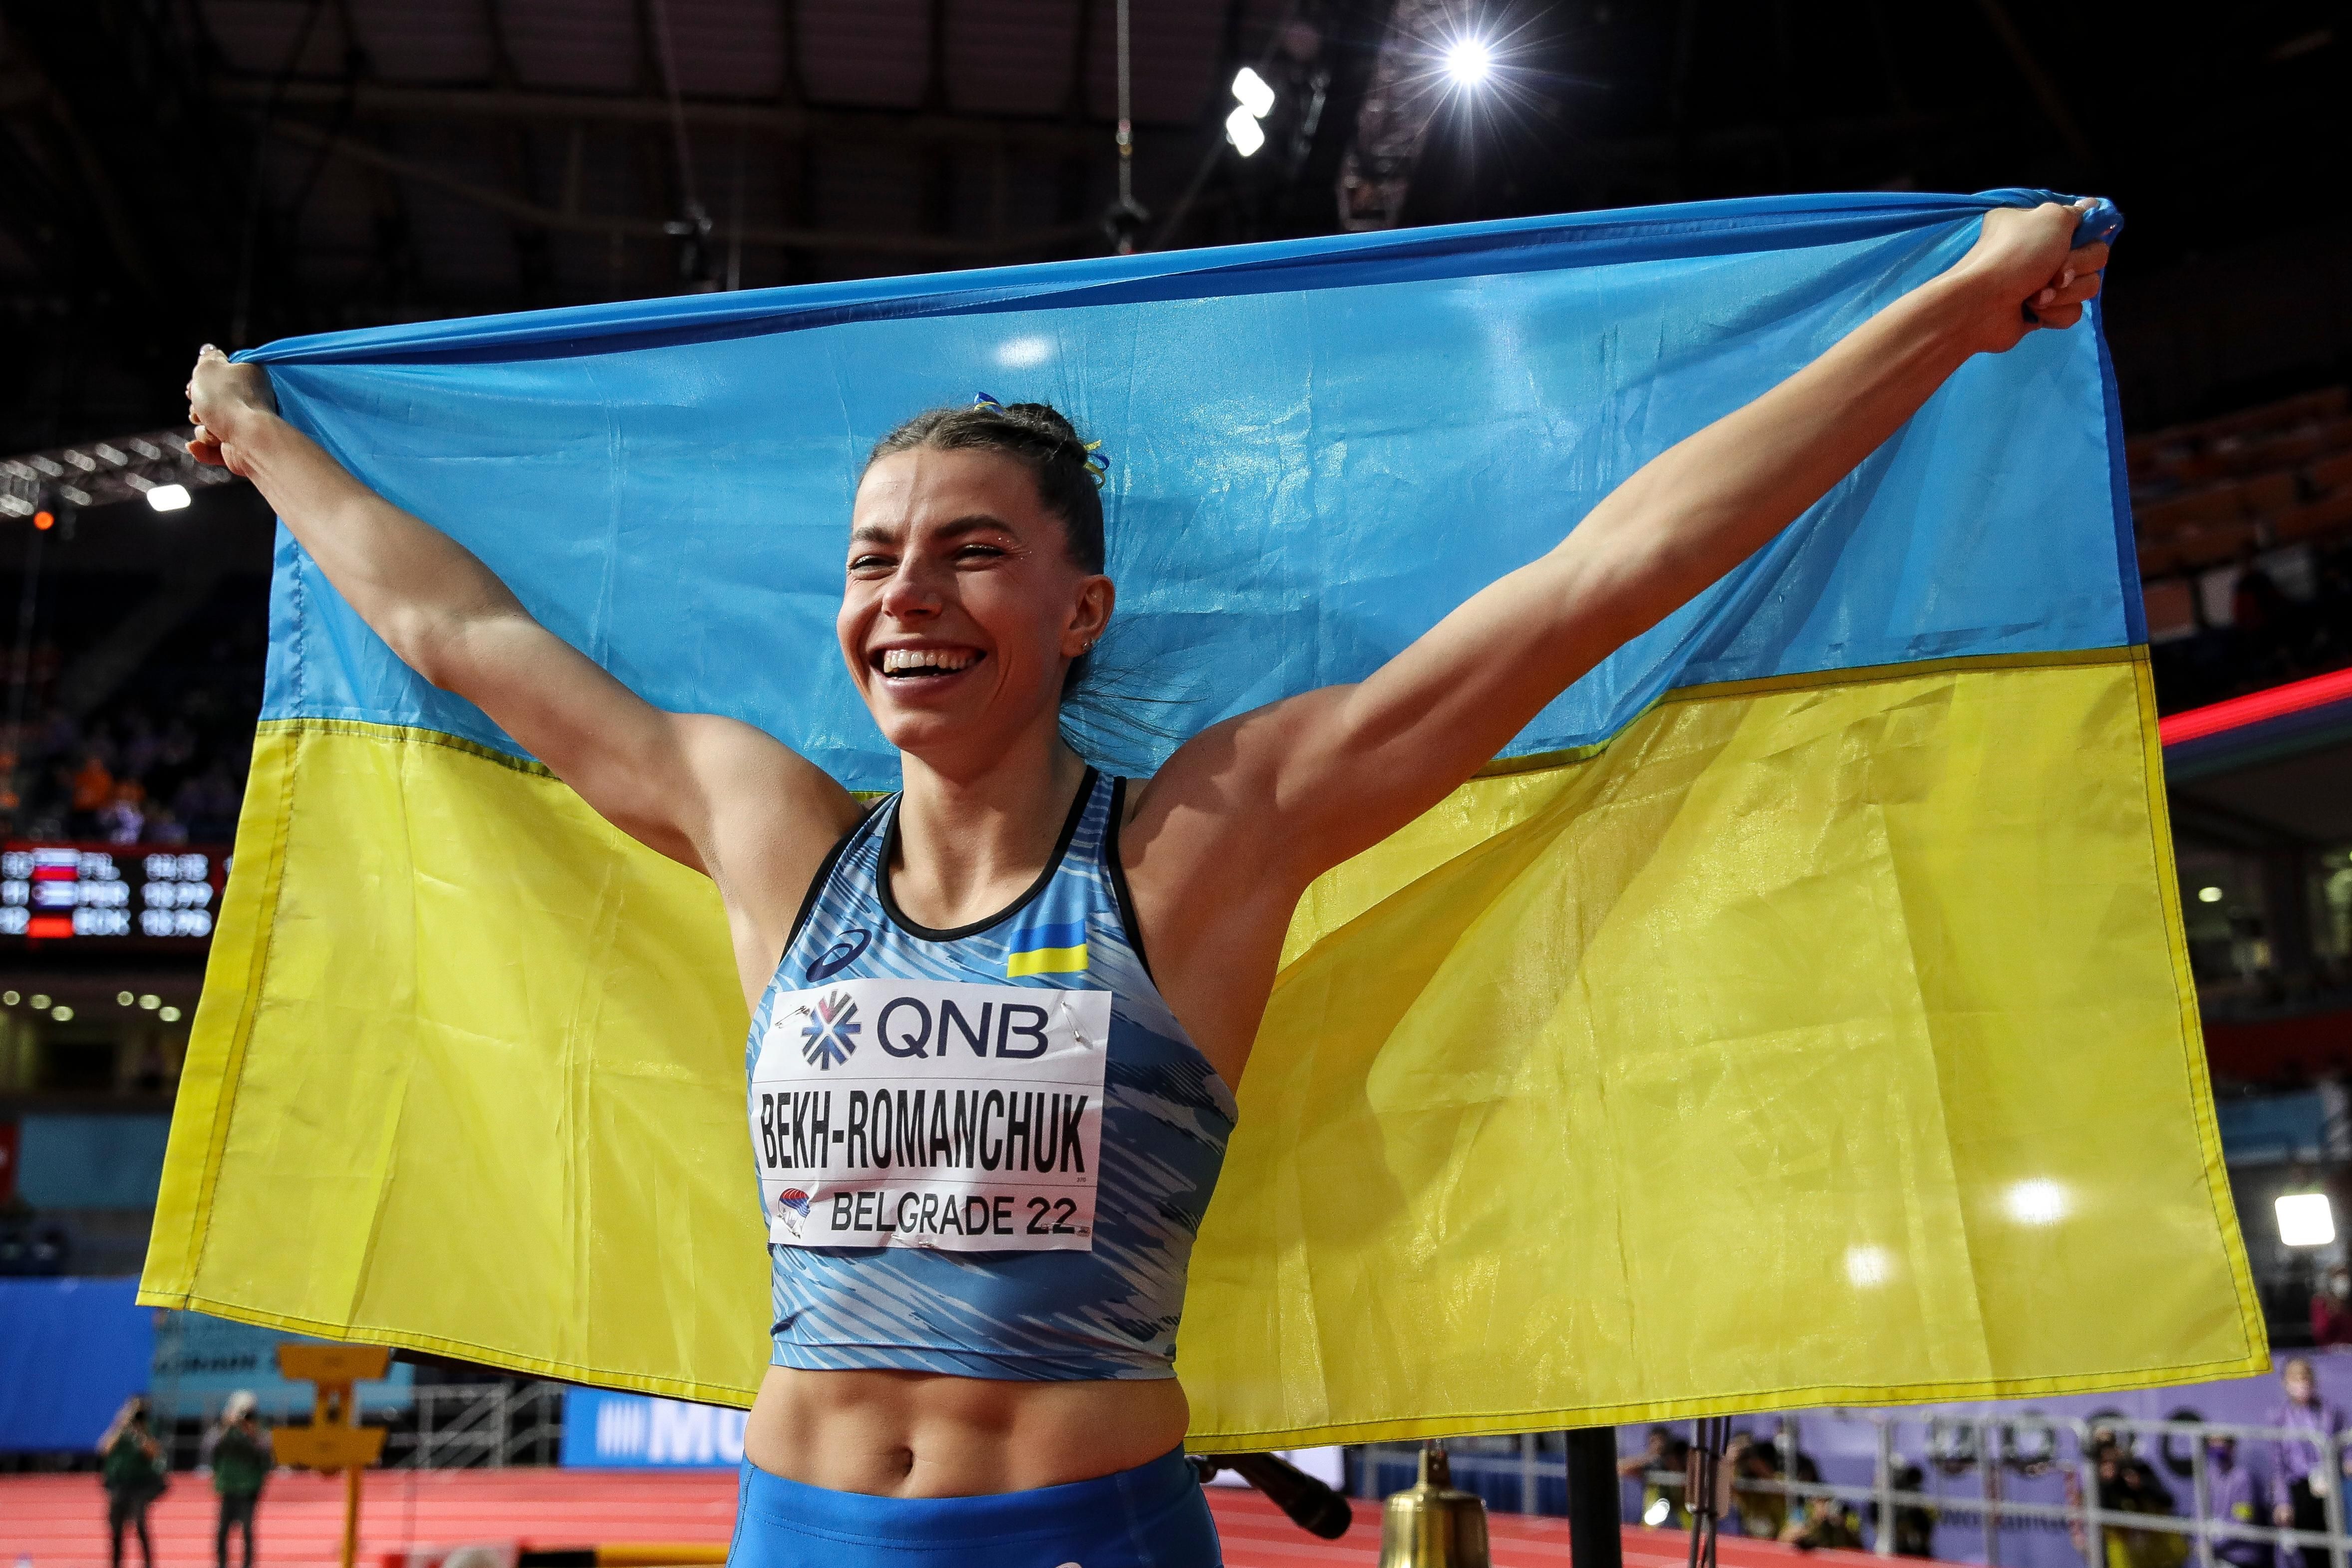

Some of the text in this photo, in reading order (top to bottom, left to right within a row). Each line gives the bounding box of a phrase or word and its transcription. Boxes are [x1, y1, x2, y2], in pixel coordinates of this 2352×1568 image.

[877, 996, 1049, 1059] QNB
[760, 1088, 1089, 1174] BEKH-ROMANCHUK
[831, 1191, 1077, 1236] BELGRADE 22
